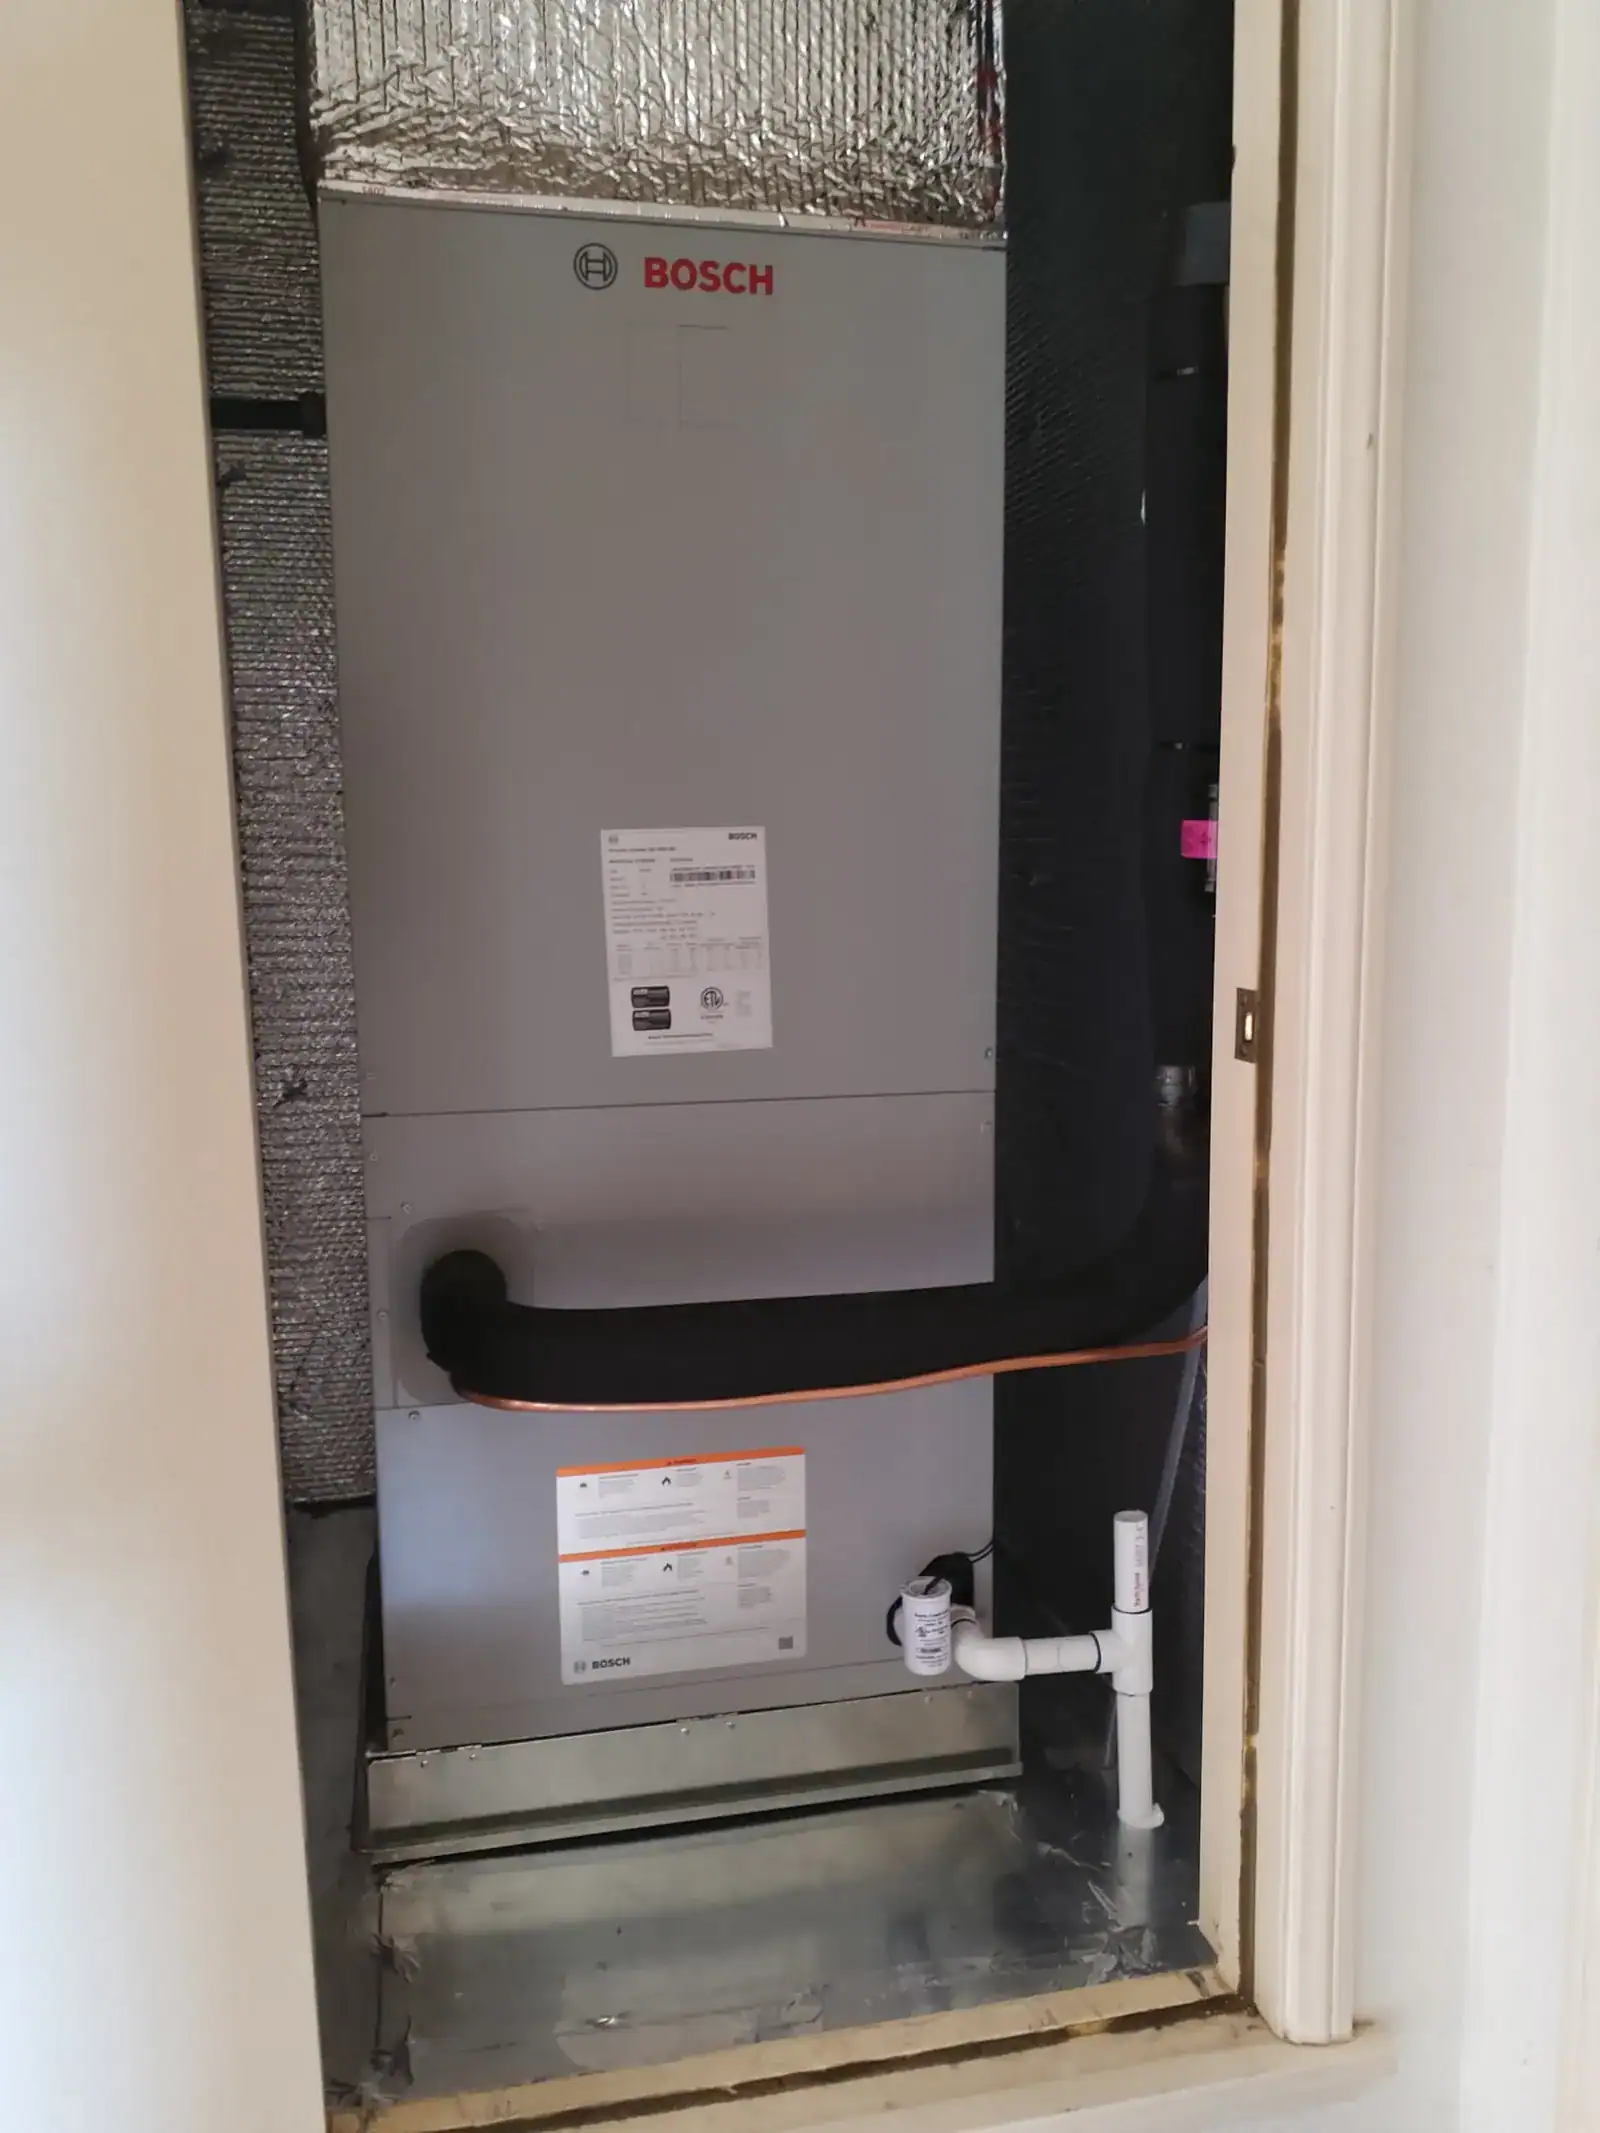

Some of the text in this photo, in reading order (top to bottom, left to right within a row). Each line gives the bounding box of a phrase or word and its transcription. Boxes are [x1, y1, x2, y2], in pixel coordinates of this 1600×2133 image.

[644, 257, 774, 295] BOSCH
[728, 832, 758, 841] BOSCH
[592, 1657, 631, 1669] BOSCH
